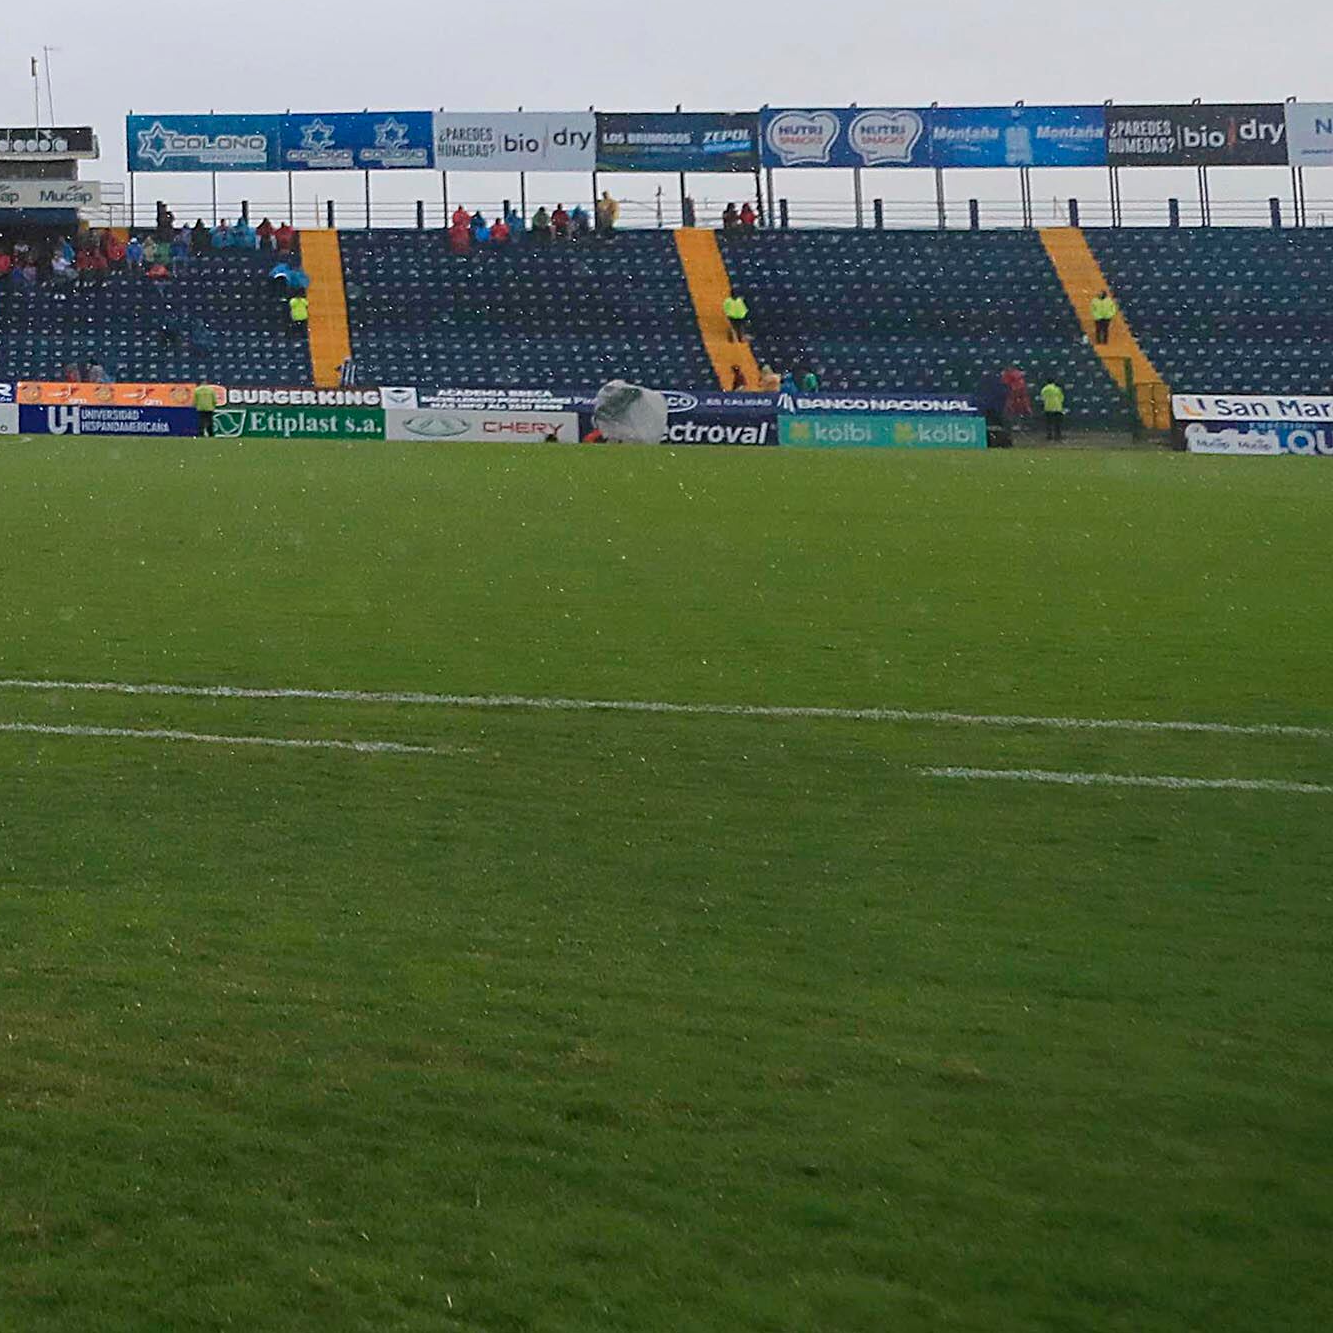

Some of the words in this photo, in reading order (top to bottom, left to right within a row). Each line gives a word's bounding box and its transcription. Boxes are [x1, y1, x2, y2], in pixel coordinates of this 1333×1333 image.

[1184, 127, 1226, 147] bio
[1240, 119, 1285, 143] dry
[1315, 119, 1333, 135] N
[170, 135, 265, 150] COLONO
[504, 134, 539, 153] bio
[552, 127, 593, 151] dry
[39, 190, 93, 204] Mucap
[796, 398, 870, 410] BANCO
[870, 399, 978, 412] NACIONAL
[1214, 399, 1271, 417] San
[1277, 400, 1333, 418] Mar
[82, 408, 140, 421] UNIVERSIDAD
[248, 413, 341, 438] Etiplast
[483, 421, 565, 435] CHERY
